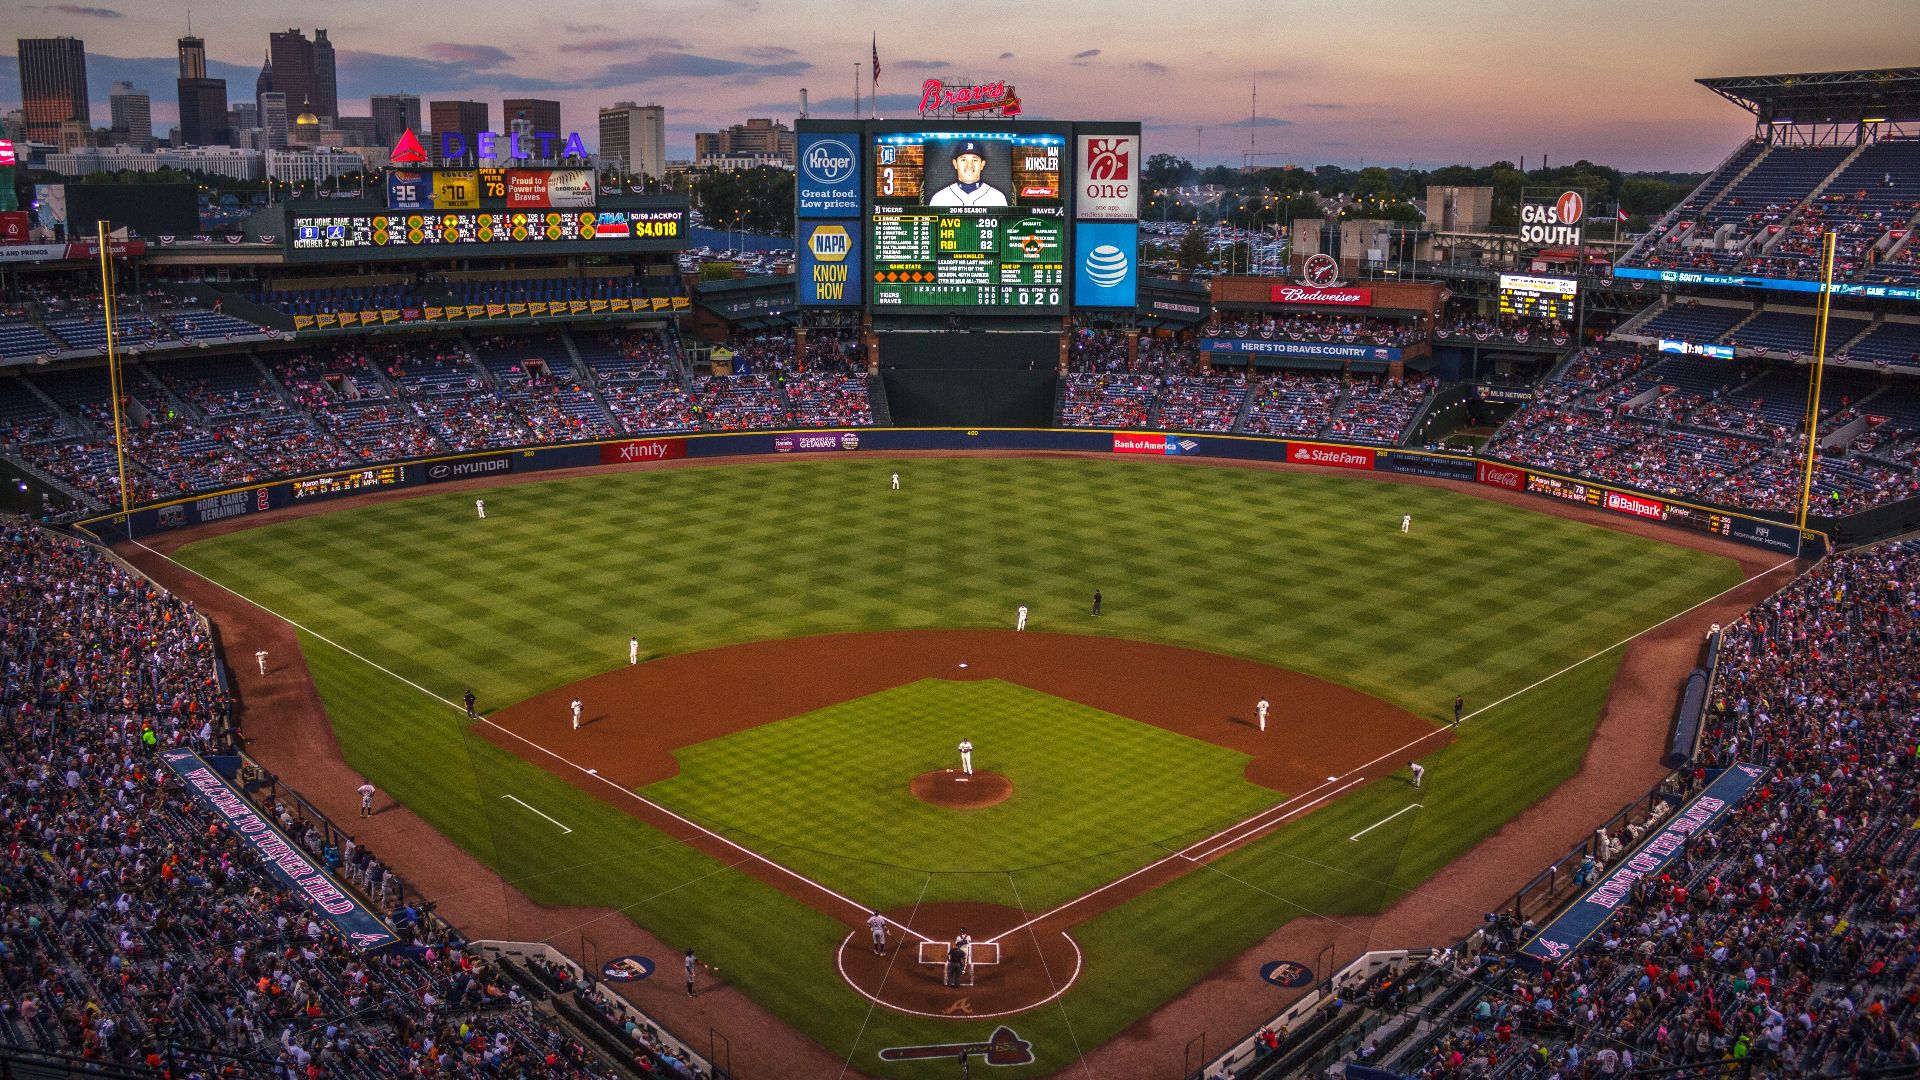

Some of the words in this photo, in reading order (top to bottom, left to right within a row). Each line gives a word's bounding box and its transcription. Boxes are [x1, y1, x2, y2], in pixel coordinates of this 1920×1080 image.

[918, 78, 1005, 115] Braves
[441, 131, 589, 159] DELTA
[1047, 147, 1059, 157] IAN
[809, 147, 850, 178] Kroger
[1025, 158, 1059, 171] KINSLER
[511, 176, 533, 185] Proud
[534, 176, 543, 185] to
[883, 167, 894, 196] 3
[486, 183, 505, 197] 78
[508, 185, 533, 193] Power
[534, 185, 546, 193] the
[801, 189, 830, 198] Great
[832, 189, 857, 198] food.
[1086, 184, 1129, 199] one
[515, 193, 541, 201] Braves
[801, 200, 823, 208] Low
[824, 200, 858, 210] prices.
[297, 218, 313, 226] NEXT
[314, 218, 332, 226] HOME
[333, 217, 350, 226] GAME
[649, 212, 683, 220] JACKPOT
[1521, 205, 1558, 224] GAS
[636, 222, 677, 237] $4,018
[940, 218, 961, 228] AVG
[976, 218, 998, 228] .290
[940, 230, 955, 239] HR
[980, 230, 993, 239] 28
[1520, 225, 1580, 246] SOUTH
[294, 239, 323, 248] OCTOBER
[816, 235, 846, 253] NAPA
[940, 241, 957, 250] RBI
[980, 241, 993, 250] 82
[813, 265, 848, 282] KNOW
[1678, 273, 1702, 283] SOUTH
[816, 283, 843, 300] HOW
[1280, 288, 1361, 302] Budweiser
[1867, 287, 1886, 295] GAME
[1019, 292, 1029, 305] 0
[1034, 292, 1044, 305] 2
[1049, 292, 1059, 305] 0
[1241, 342, 1273, 352] HERE'S
[1274, 344, 1285, 352] TO
[1286, 344, 1322, 354] BRAVES
[1323, 346, 1366, 357] COUNTRY
[1504, 391, 1533, 399] NETWOR
[799, 440, 836, 448] GETAWAYS
[1114, 440, 1135, 449] Bank
[1135, 441, 1144, 449] of
[1144, 441, 1177, 450] America
[620, 443, 667, 461] xfinity
[453, 460, 509, 475] HYUNDAI
[363, 471, 374, 479] 78
[363, 478, 378, 486] MPH
[1487, 468, 1519, 487] Coca-Cola
[1575, 485, 1584, 495] 78
[196, 497, 220, 511] HOME
[221, 491, 249, 505] GAMES
[256, 488, 269, 511] 2
[1573, 493, 1586, 502] MPH
[201, 503, 247, 522] REMAINING
[1619, 498, 1660, 517] Ballpark
[1670, 506, 1690, 517] Kinsler
[1733, 531, 1763, 543] NORTHSIDE
[1764, 538, 1791, 549] HOSPITAL
[184, 767, 253, 819] WELCOME
[1667, 795, 1725, 836] BRAVES
[233, 814, 267, 833] TO
[1642, 831, 1687, 857] THE
[249, 829, 315, 880] TURNER
[1627, 851, 1662, 872] OF
[296, 874, 354, 915] FIELD
[1586, 867, 1644, 909] HOME
